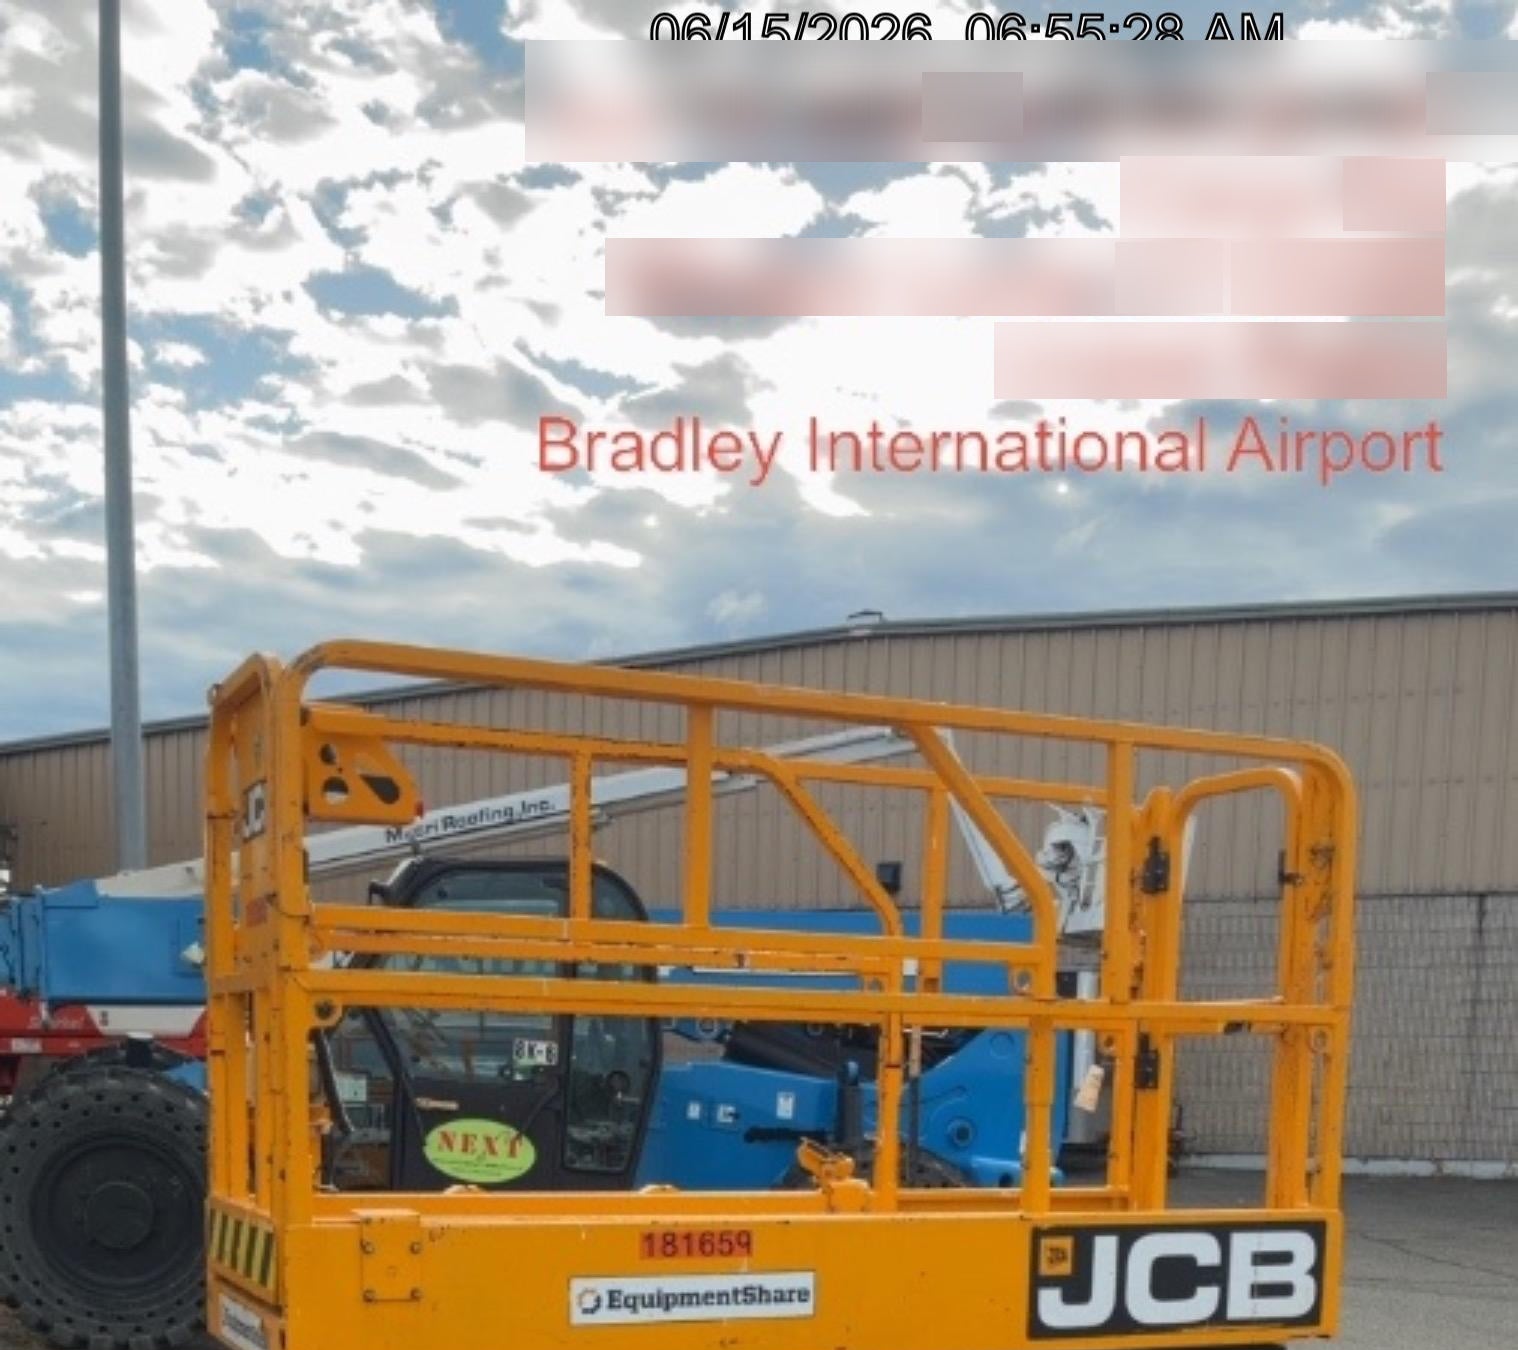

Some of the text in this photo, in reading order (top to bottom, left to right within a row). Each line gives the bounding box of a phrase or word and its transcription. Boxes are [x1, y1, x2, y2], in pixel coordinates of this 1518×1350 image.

[438, 1130, 523, 1158] NEXT
[643, 1231, 751, 1258] 181659
[1037, 1230, 1317, 1328] JCB
[606, 1284, 810, 1313] EquipmentShare
